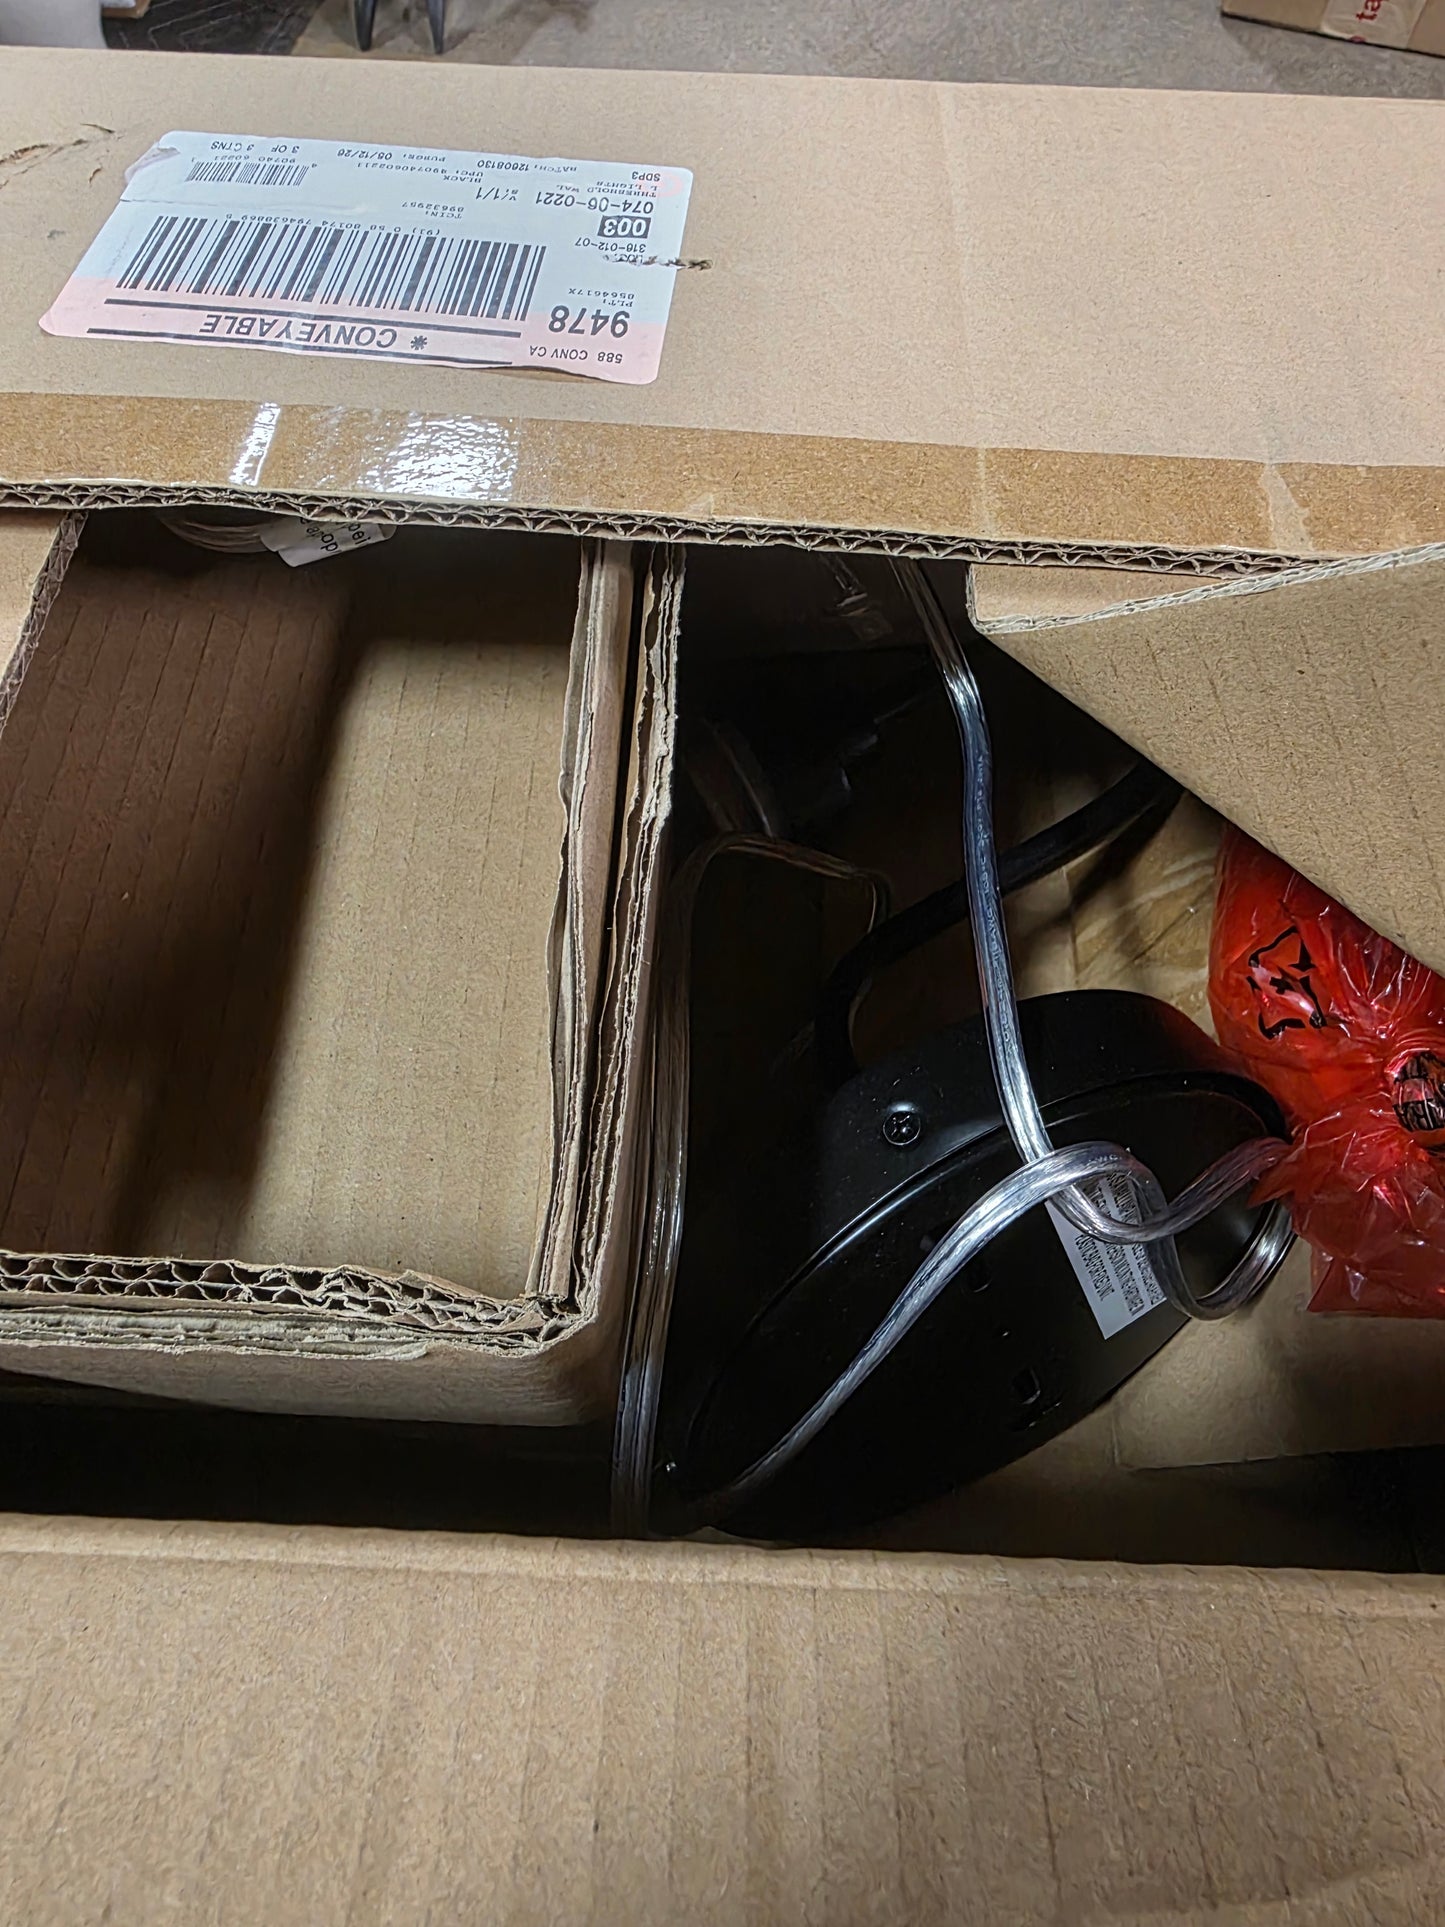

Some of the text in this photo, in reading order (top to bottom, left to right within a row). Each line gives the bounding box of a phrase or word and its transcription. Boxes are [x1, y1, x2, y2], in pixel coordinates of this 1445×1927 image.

[210, 141, 242, 152] CTNS
[271, 145, 287, 153] OF
[443, 175, 481, 183] BLACK
[632, 172, 661, 181] SDP3
[587, 187, 656, 198] THRESHOLD
[535, 192, 653, 214] 074-06-0221
[604, 218, 646, 236] 003
[548, 305, 630, 338] 9478
[199, 314, 397, 348] CONVEYABLE
[529, 346, 622, 364] 588 CONV CA
